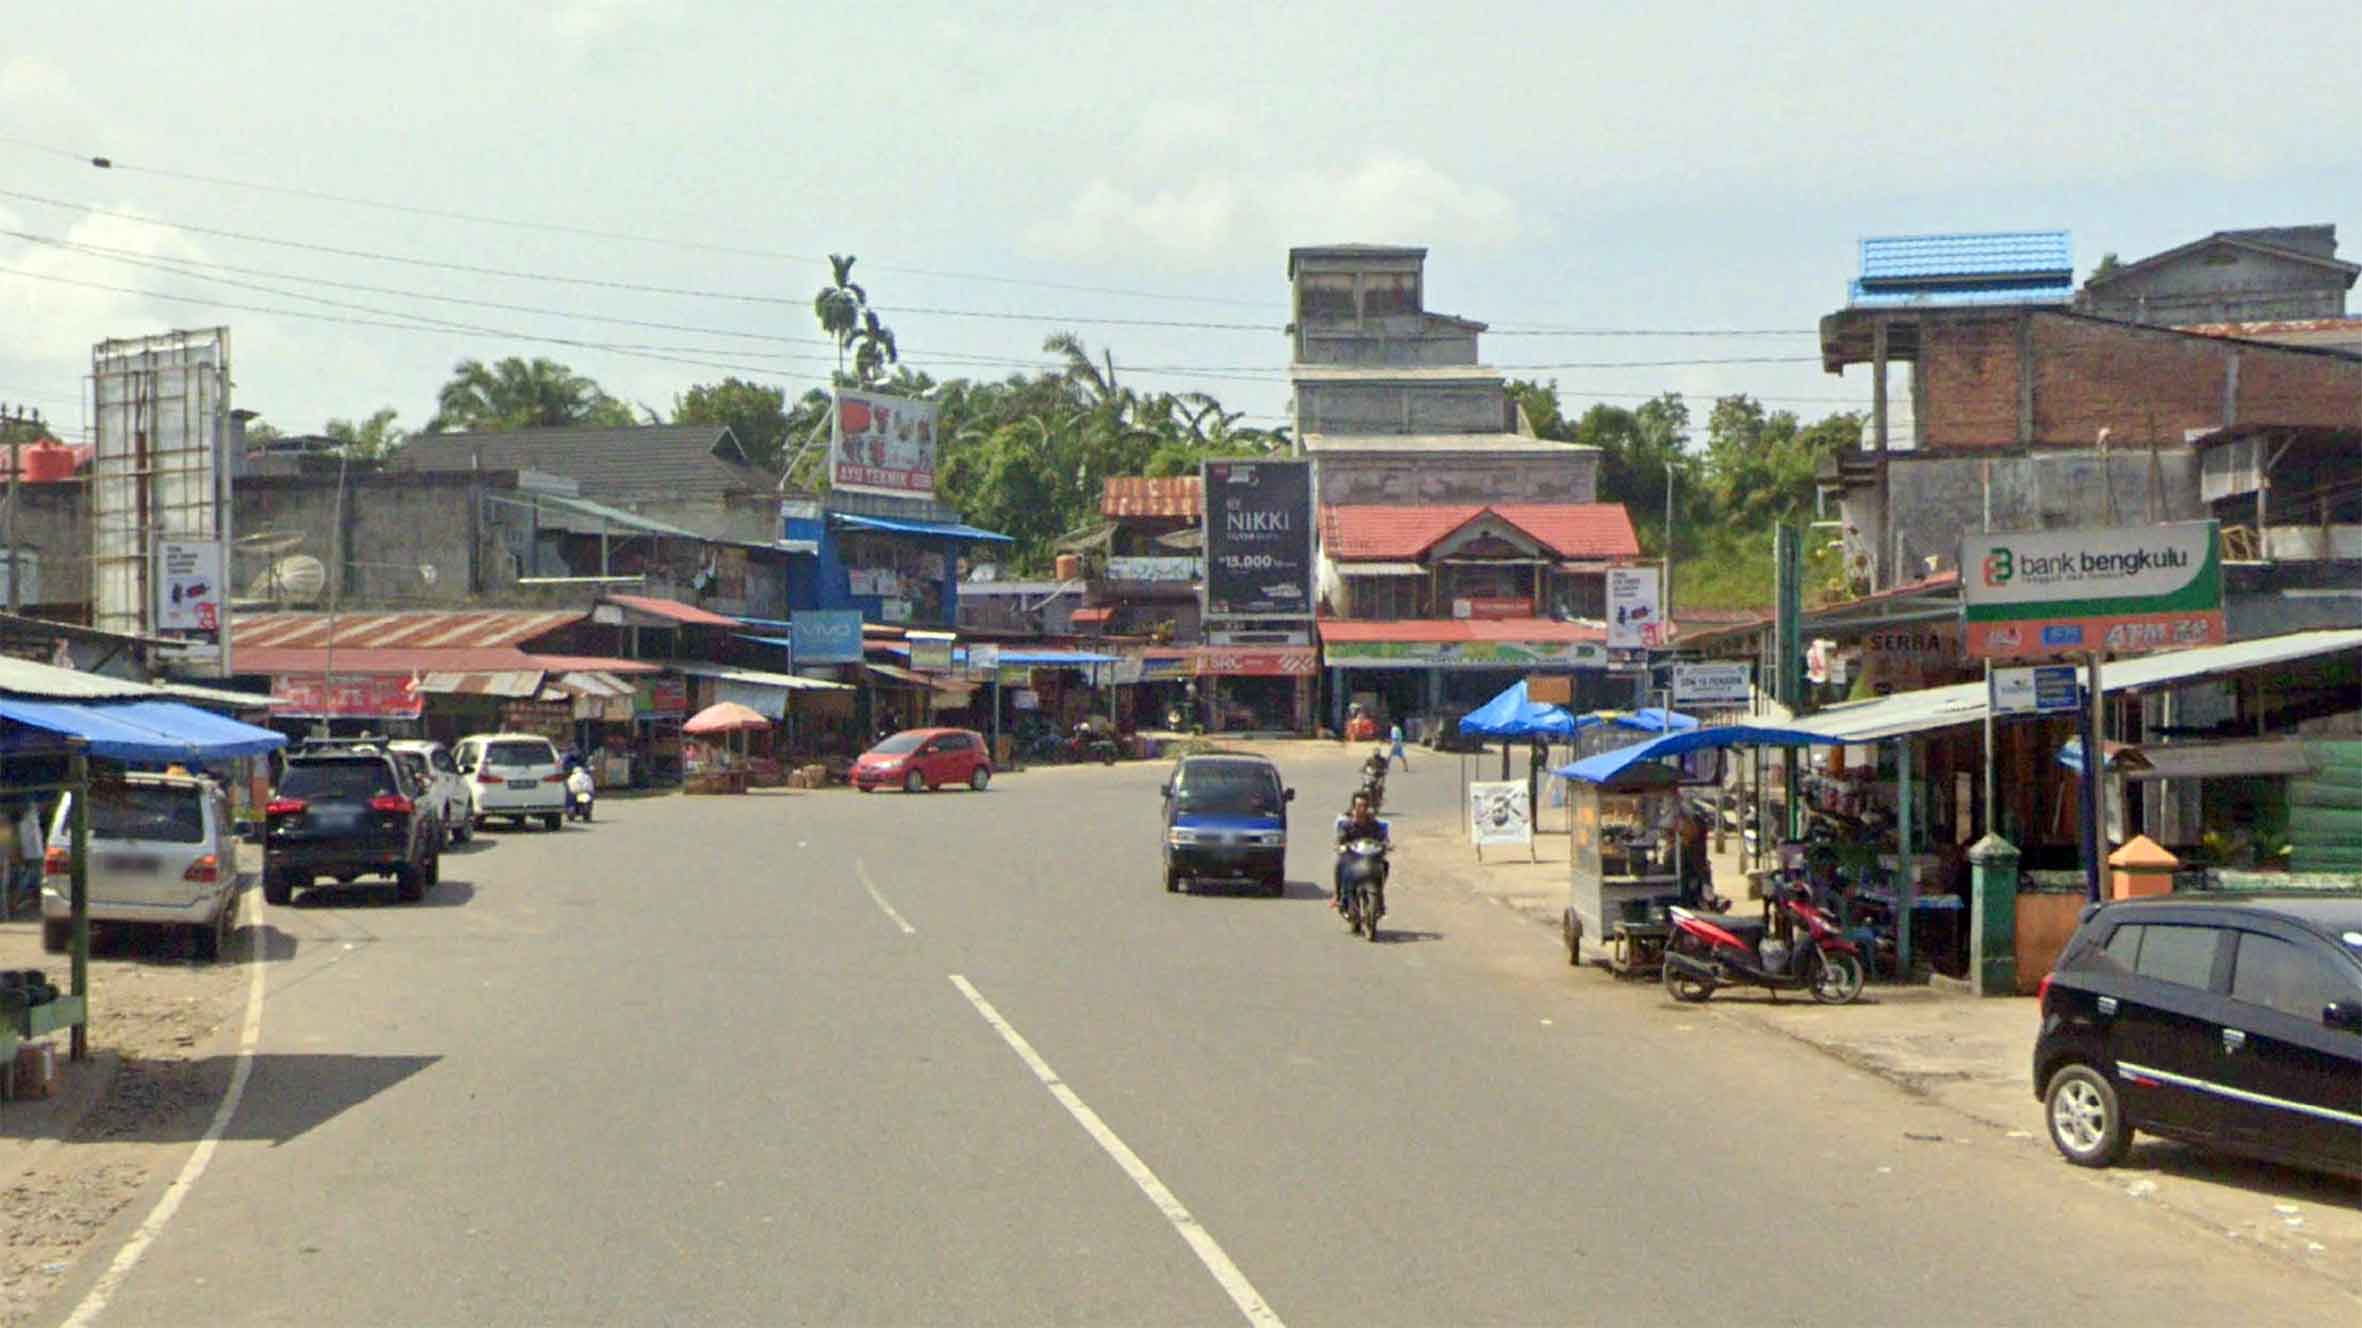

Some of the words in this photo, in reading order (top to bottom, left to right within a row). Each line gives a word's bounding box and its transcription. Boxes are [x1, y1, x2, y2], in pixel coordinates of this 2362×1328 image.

[1227, 512, 1289, 530] NIKKI
[2020, 553, 2075, 576] bank
[2080, 549, 2187, 575] bengkulu
